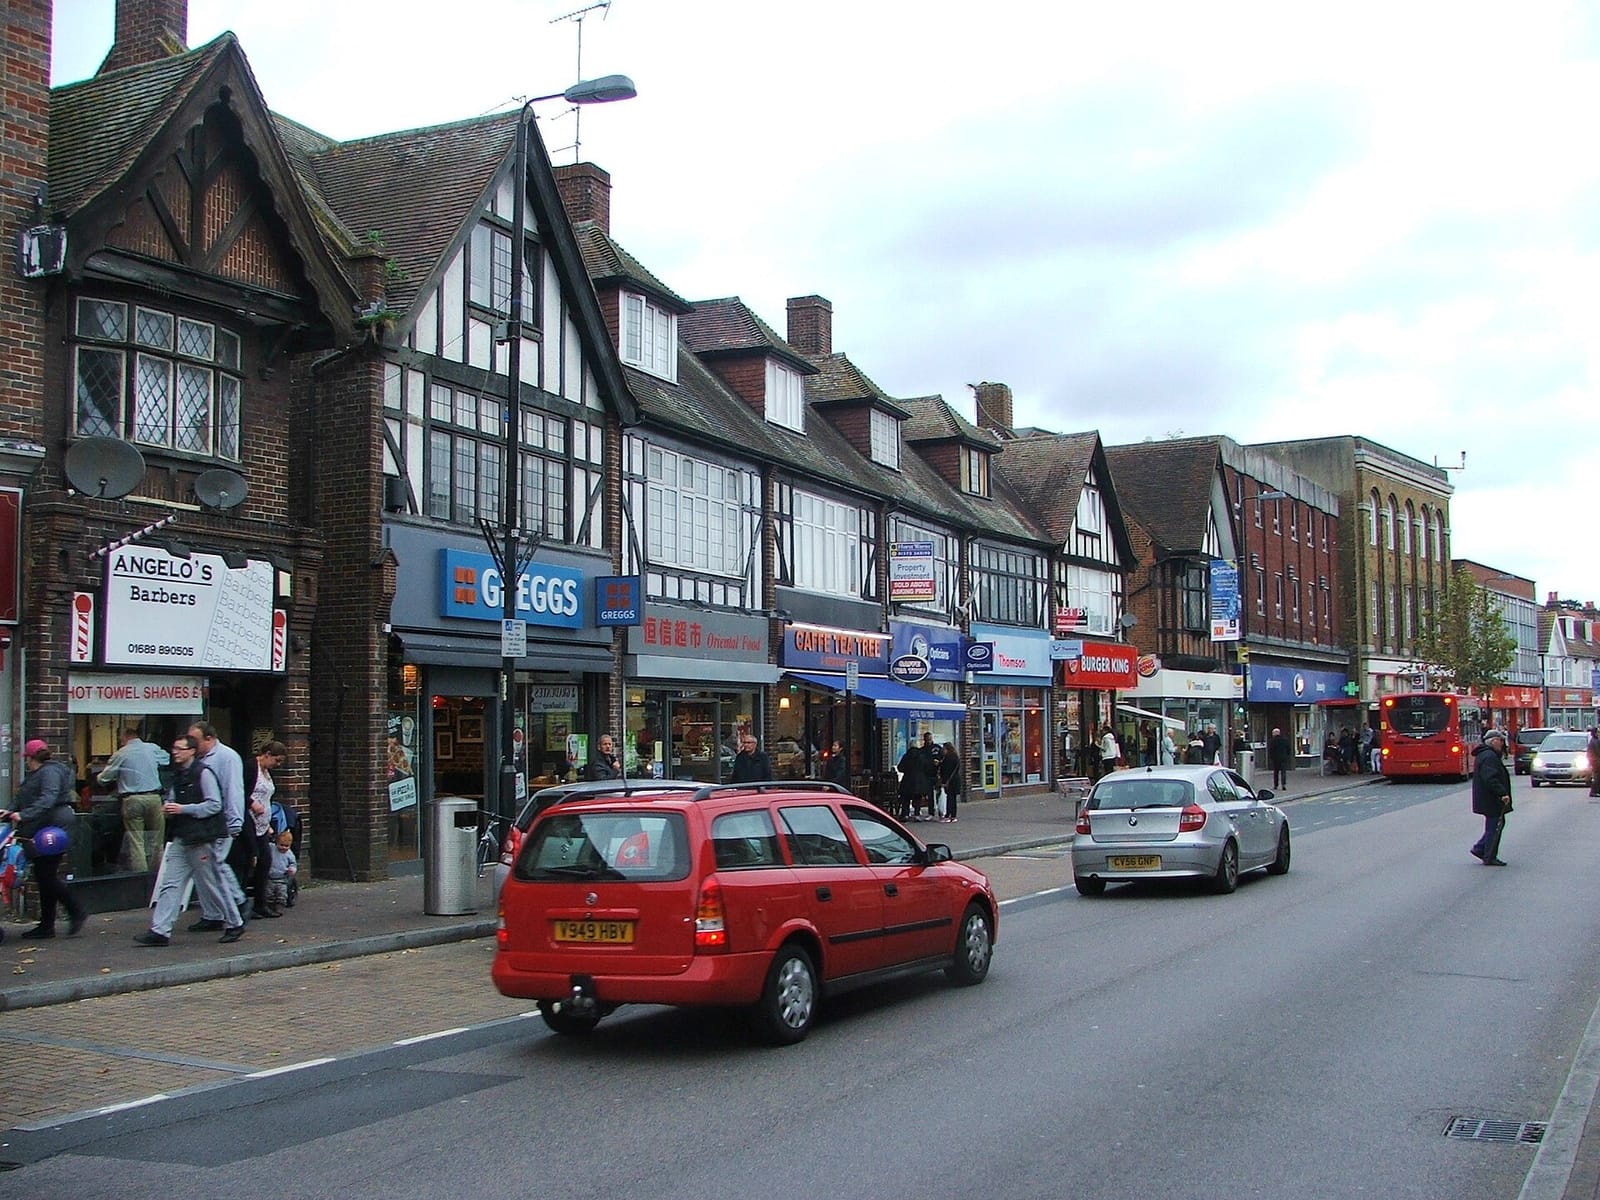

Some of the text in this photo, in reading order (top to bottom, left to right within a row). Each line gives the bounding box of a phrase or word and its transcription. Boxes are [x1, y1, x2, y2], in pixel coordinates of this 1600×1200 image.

[114, 555, 212, 581] ANGELO'S
[130, 585, 196, 606] Barbers
[481, 568, 578, 617] GEGGS
[601, 610, 635, 620] GREGGS
[214, 608, 266, 650] Barbers
[643, 616, 702, 649] 恒信超市
[128, 643, 156, 655] 01689
[209, 626, 263, 668] Barbers
[795, 630, 882, 658] CAFFE TEA TREE
[999, 654, 1026, 669] Thomson
[1081, 655, 1129, 674] BURGER KING
[67, 686, 93, 699] HOT
[96, 686, 140, 699] TOWEL
[143, 686, 189, 699] SHAVES
[559, 923, 596, 938] V949
